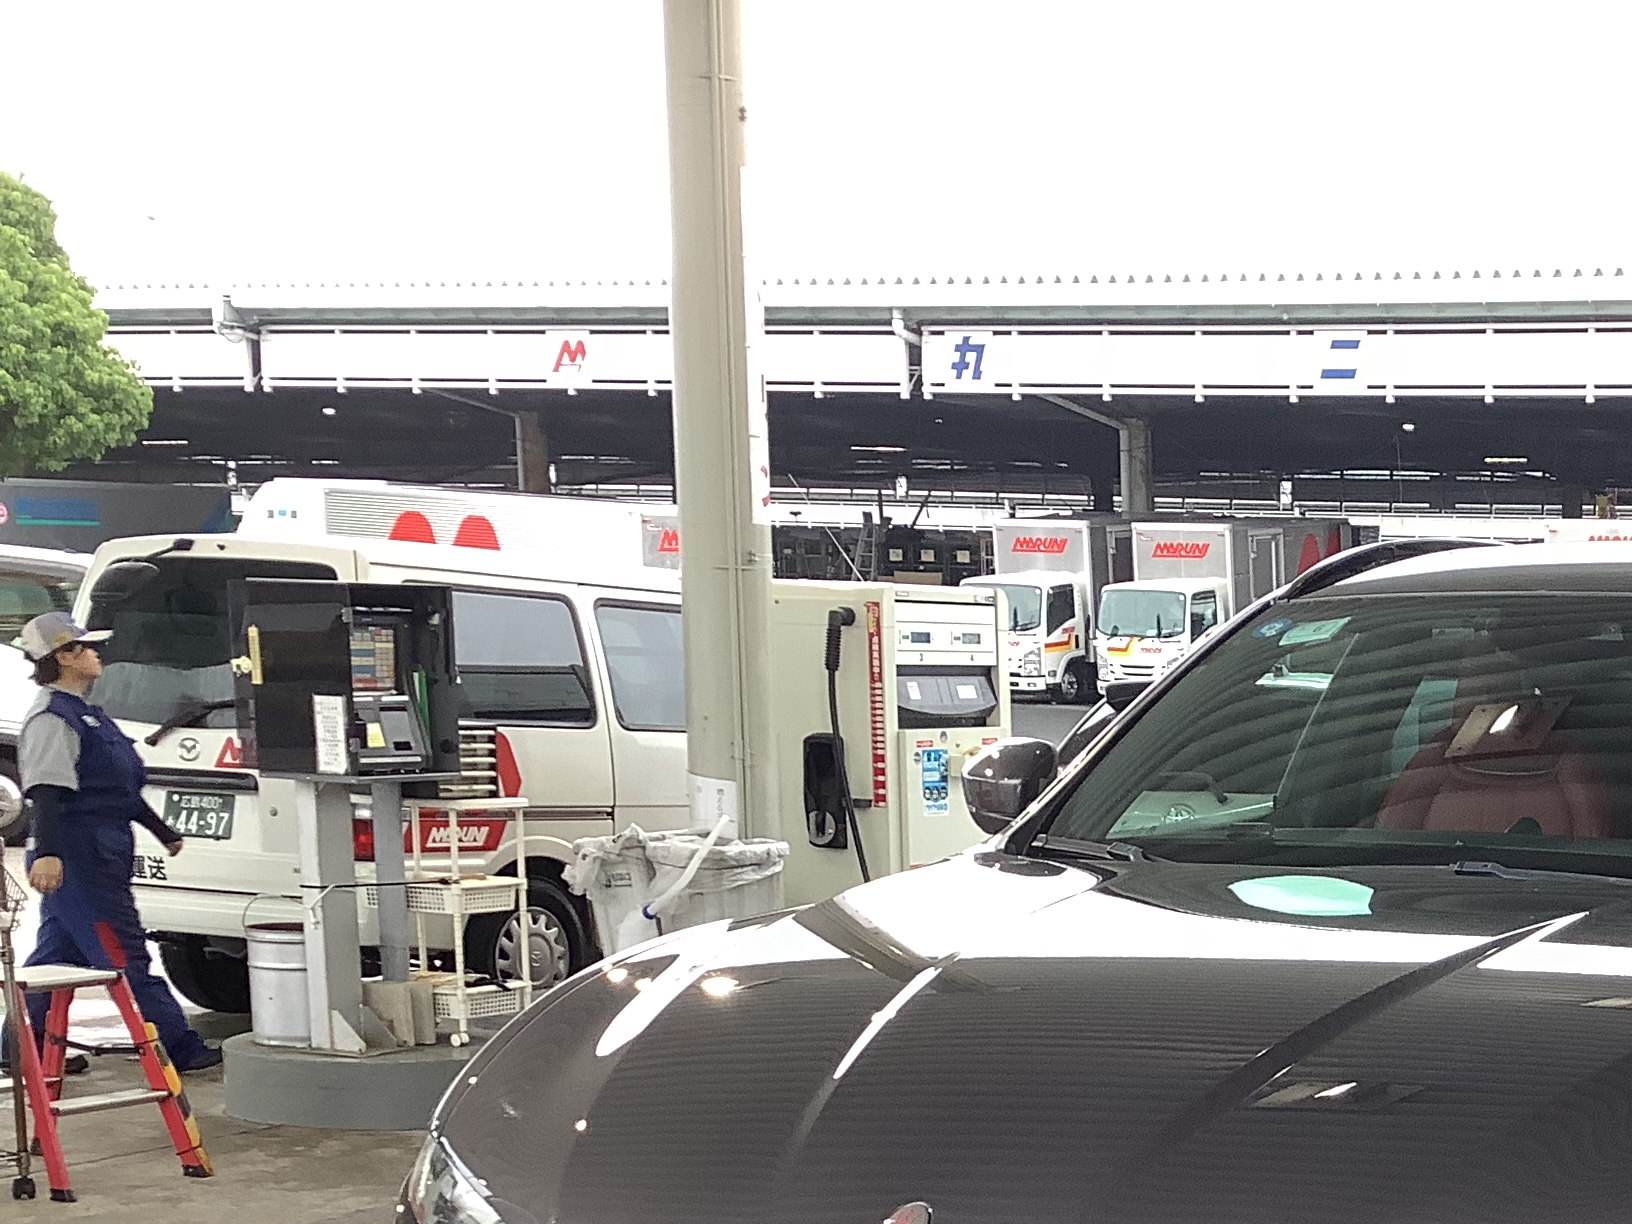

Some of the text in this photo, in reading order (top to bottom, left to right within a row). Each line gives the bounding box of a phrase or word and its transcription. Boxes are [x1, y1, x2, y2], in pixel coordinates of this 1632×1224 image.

[1012, 537, 1069, 554] MARUNI
[1152, 542, 1210, 560] MARUNI
[176, 810, 230, 836] 44-97
